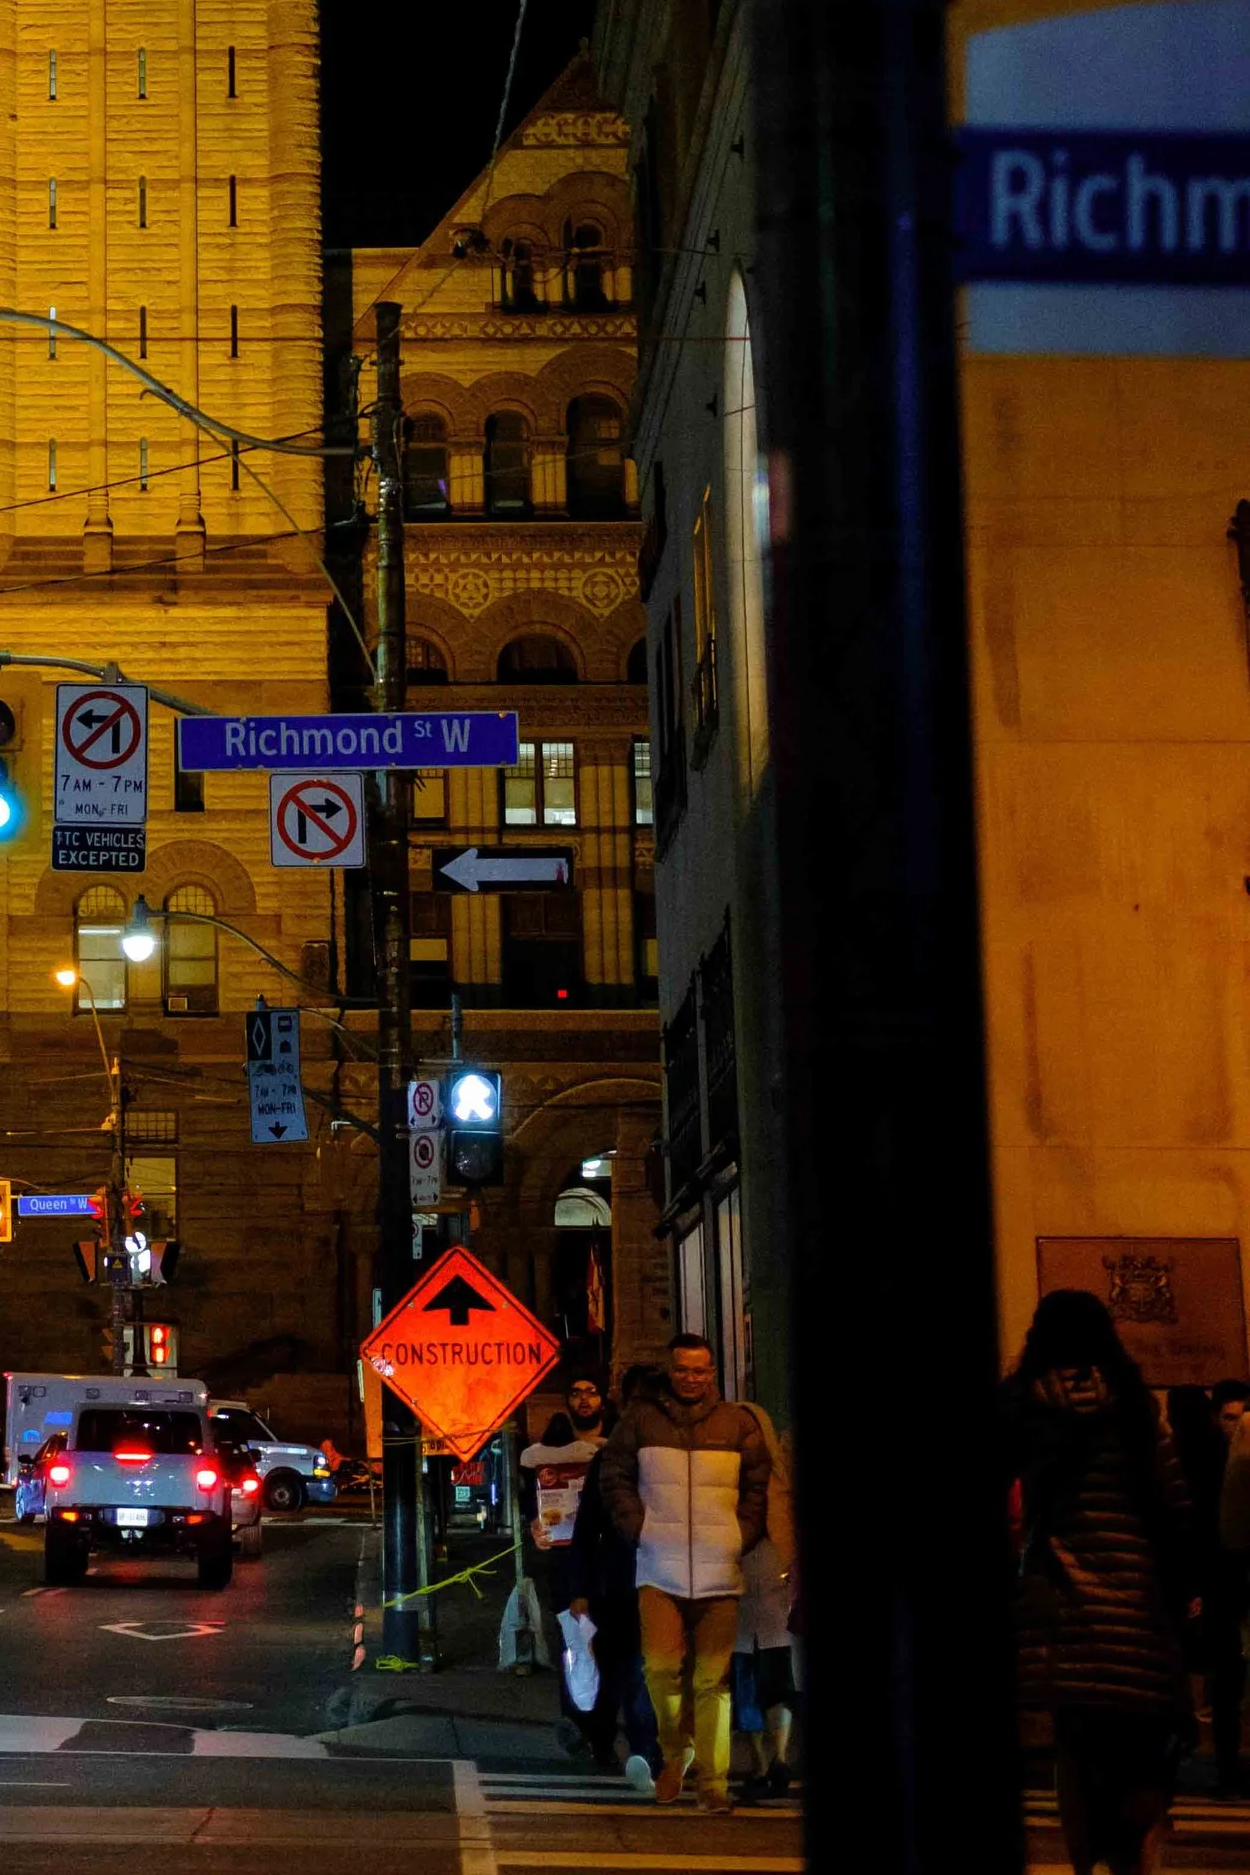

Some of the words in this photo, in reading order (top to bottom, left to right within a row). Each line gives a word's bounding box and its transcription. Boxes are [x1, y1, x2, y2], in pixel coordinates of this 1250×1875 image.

[225, 720, 403, 756] Richmond
[413, 720, 433, 738] St
[440, 719, 471, 753] W
[55, 831, 80, 846] TTC
[86, 832, 144, 848] VEHICLES
[58, 850, 139, 866] EXCEPTED
[30, 1198, 67, 1211] Queen
[78, 1197, 88, 1210] W
[382, 1342, 542, 1366] CONSTRUCTION
